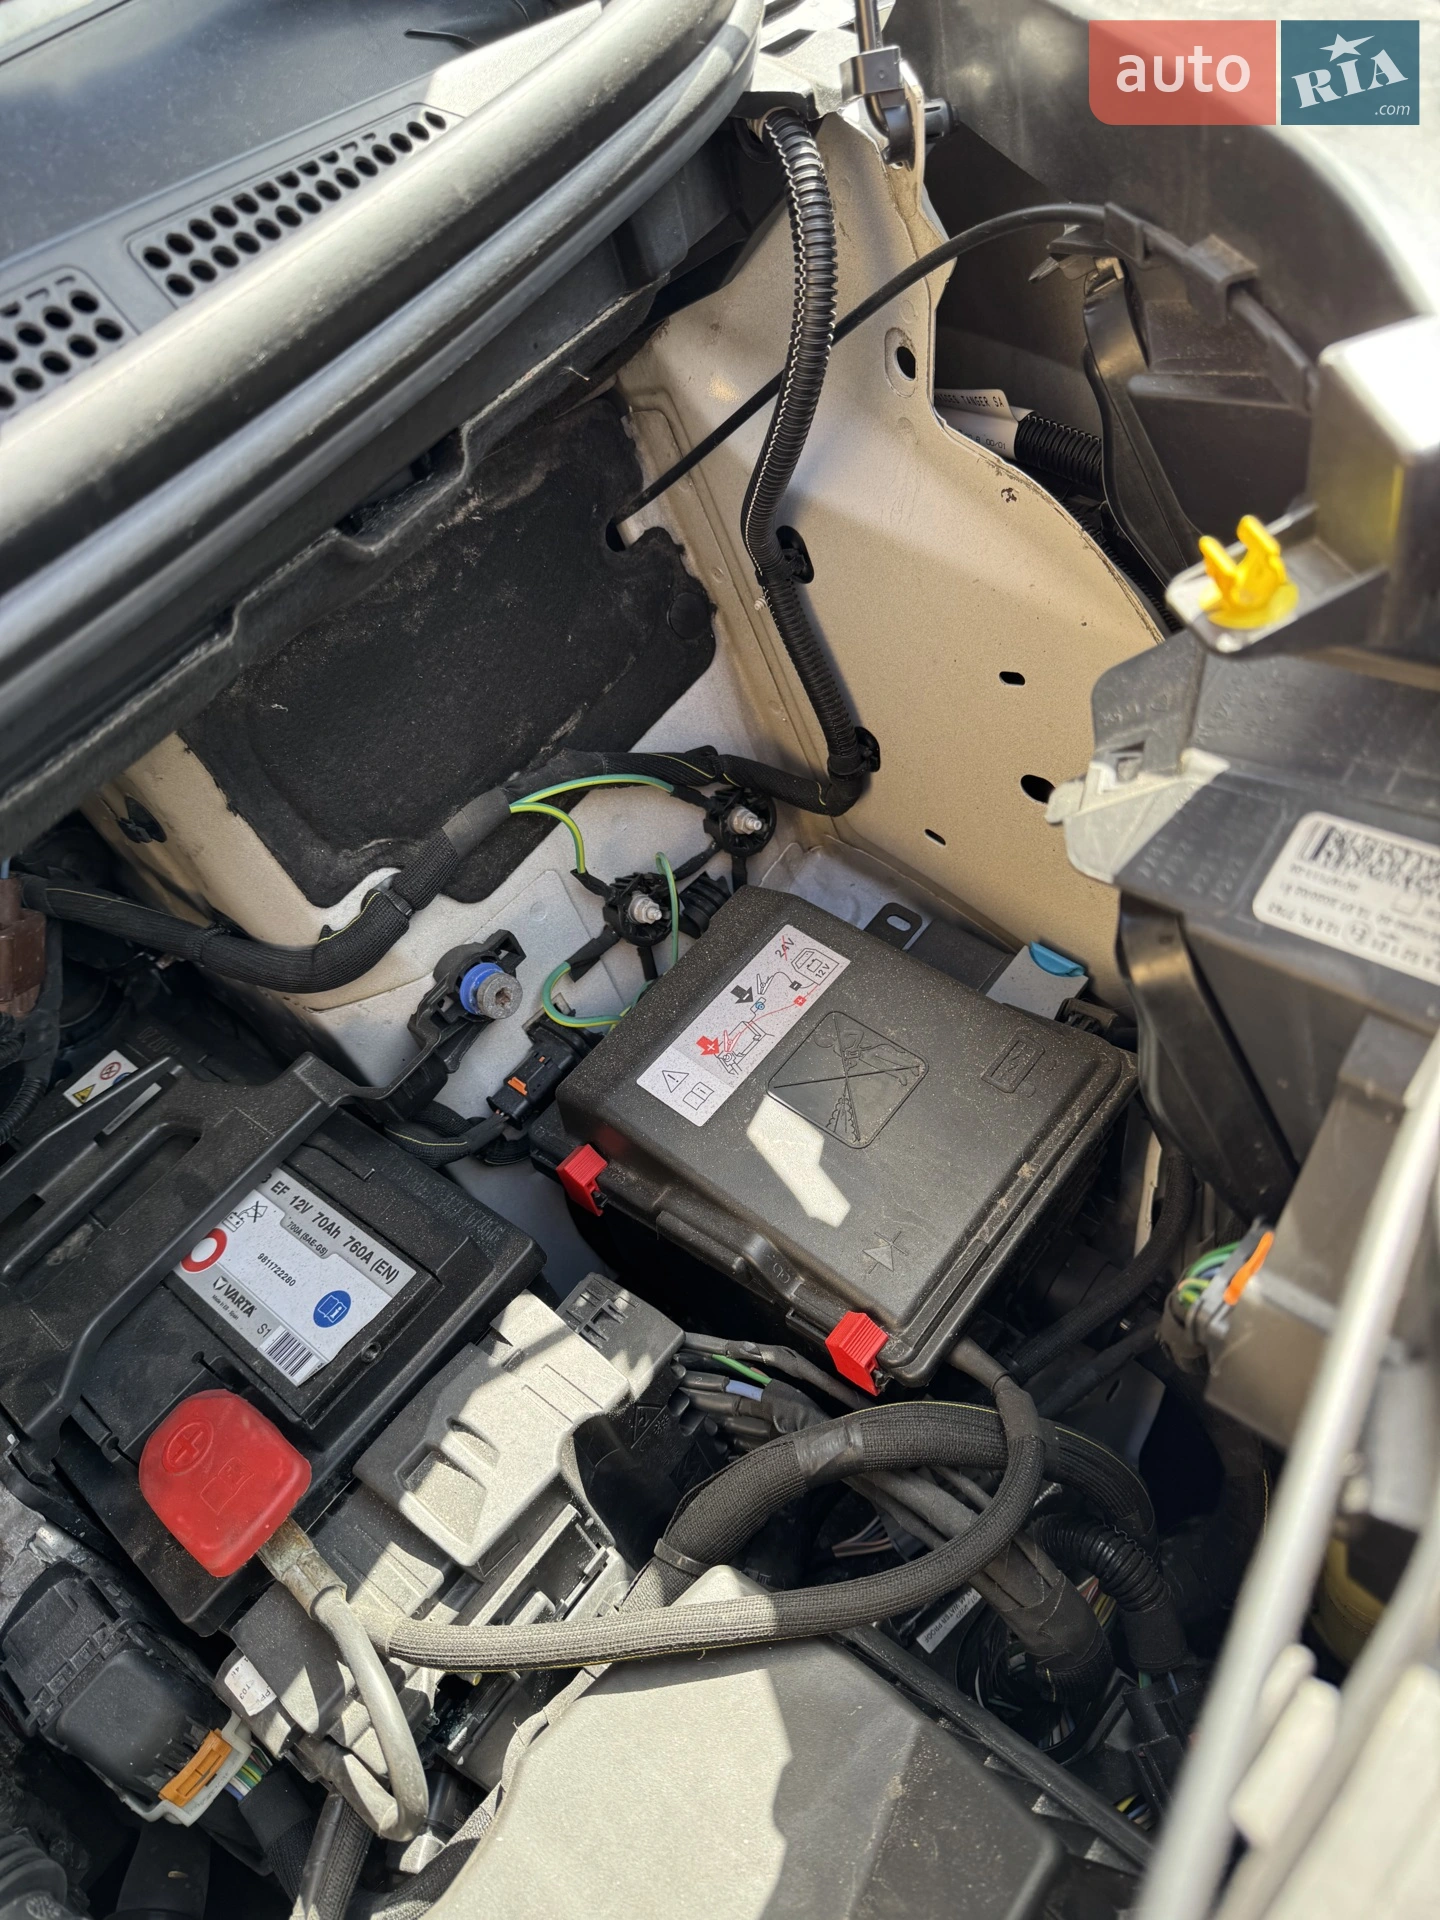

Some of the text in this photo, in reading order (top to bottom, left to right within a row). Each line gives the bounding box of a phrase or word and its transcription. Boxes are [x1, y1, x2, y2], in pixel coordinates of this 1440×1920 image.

[960, 395, 991, 407] TANGER
[992, 395, 1005, 408] SA
[270, 1180, 291, 1196] EF
[289, 1195, 314, 1215] 12V
[311, 1211, 342, 1239] 70Ah
[342, 1235, 375, 1265] 760A
[369, 1257, 400, 1285] (EN)
[286, 1221, 302, 1236] 700A
[223, 1283, 257, 1318] VARTA
[256, 1323, 272, 1339] S1
